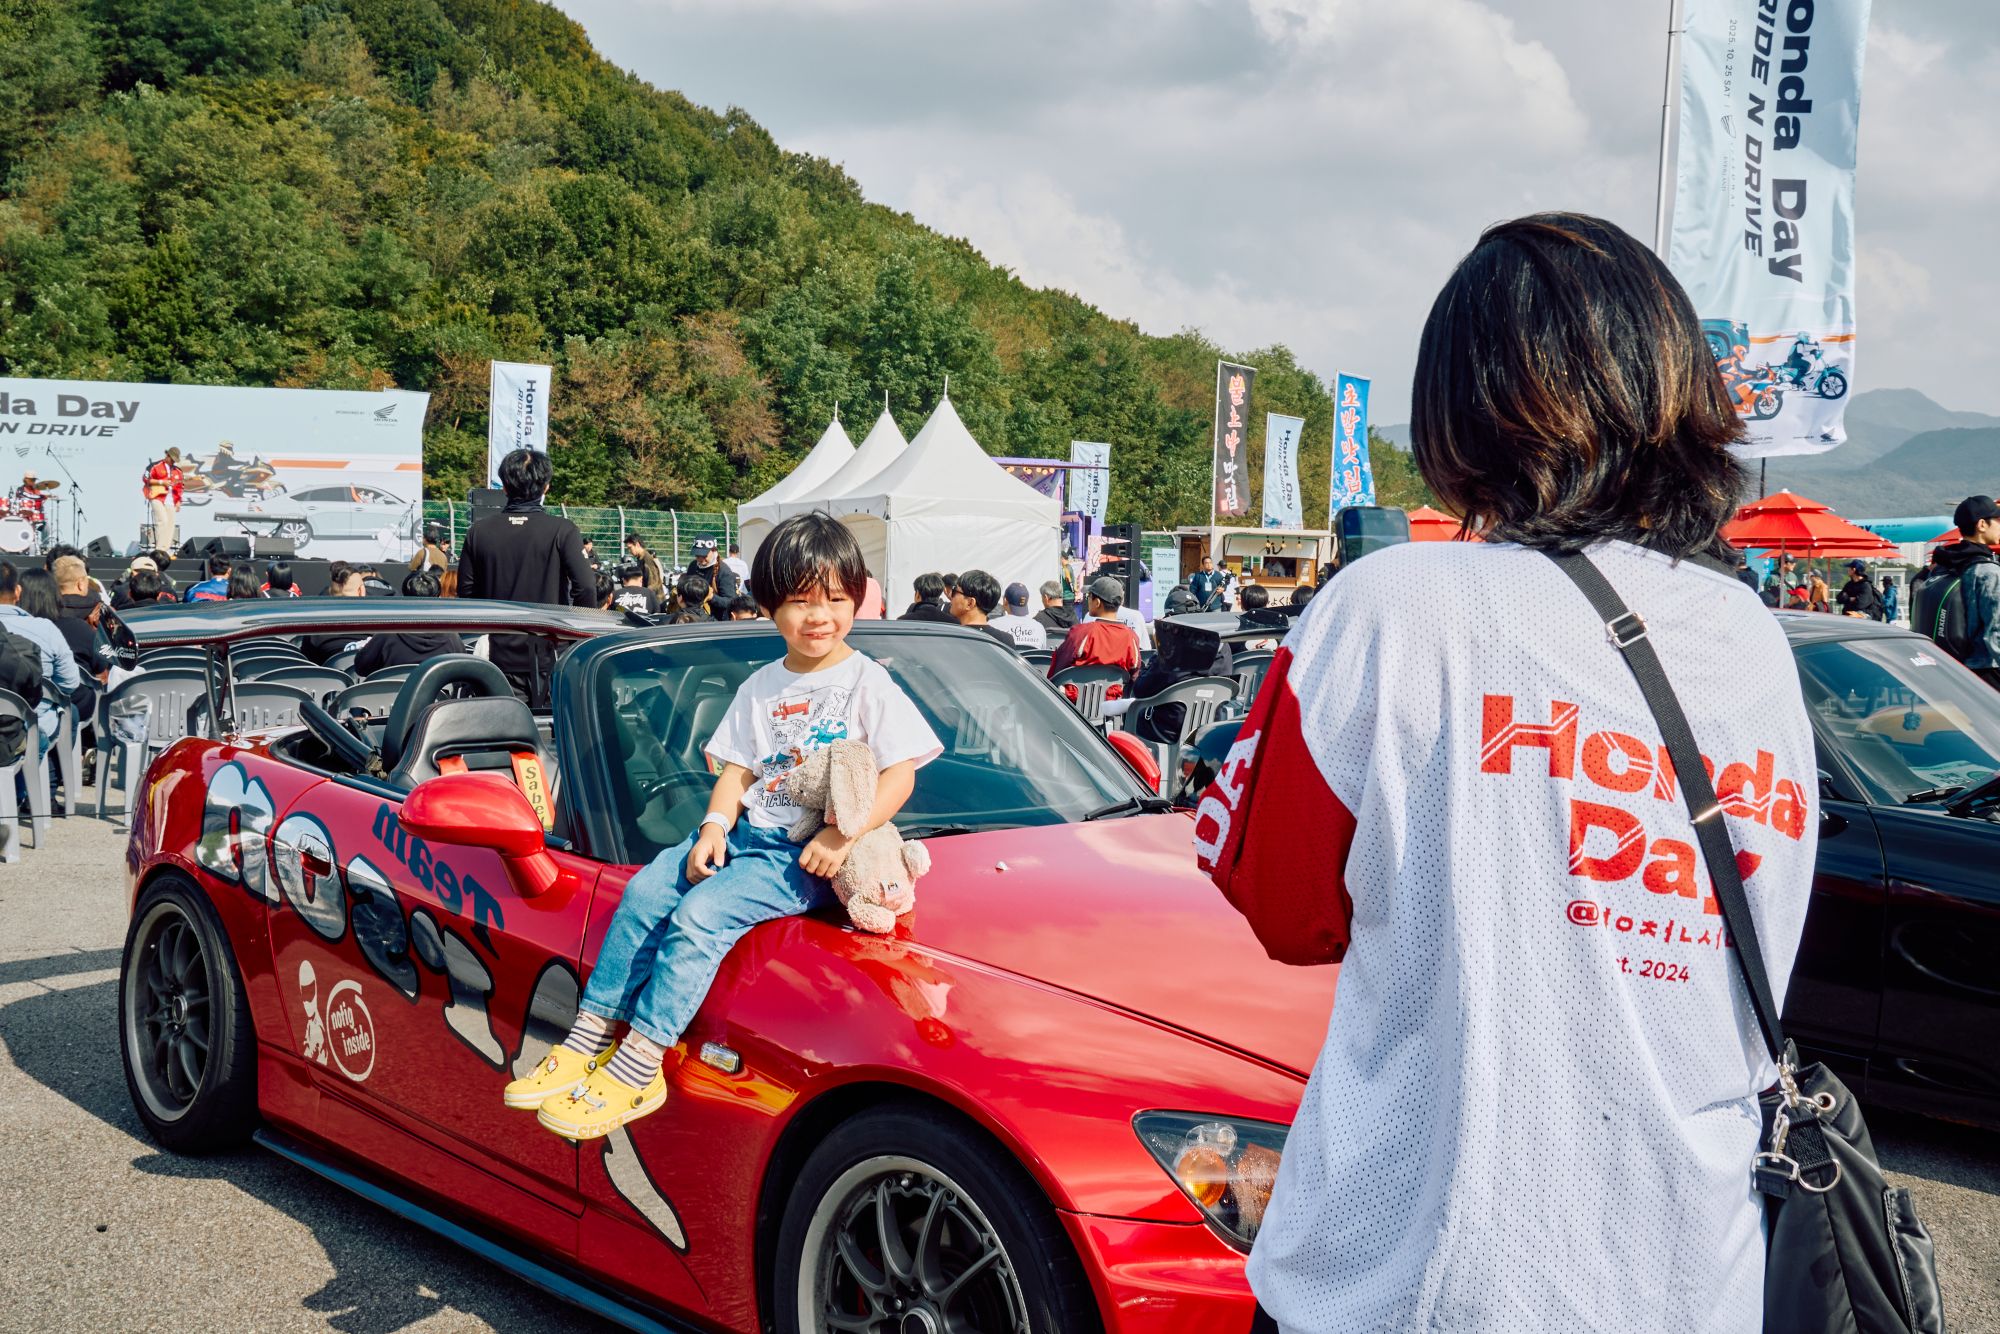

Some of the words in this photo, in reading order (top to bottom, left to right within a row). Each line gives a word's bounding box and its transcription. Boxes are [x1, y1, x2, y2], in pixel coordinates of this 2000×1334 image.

[1748, 92, 1766, 127] N
[1744, 133, 1763, 258] DRIVE
[1768, 178, 1807, 284] Day
[57, 394, 140, 423] Day
[525, 379, 537, 436] Honda
[27, 423, 119, 437] DRIVE
[1091, 454, 1102, 494] Hnda
[1286, 482, 1294, 511] Day
[1937, 608, 1948, 638] paxton
[1193, 729, 1262, 880] DA
[1639, 959, 1690, 983] 2024
[341, 1024, 371, 1057] inside
[577, 1116, 625, 1137] crocs
